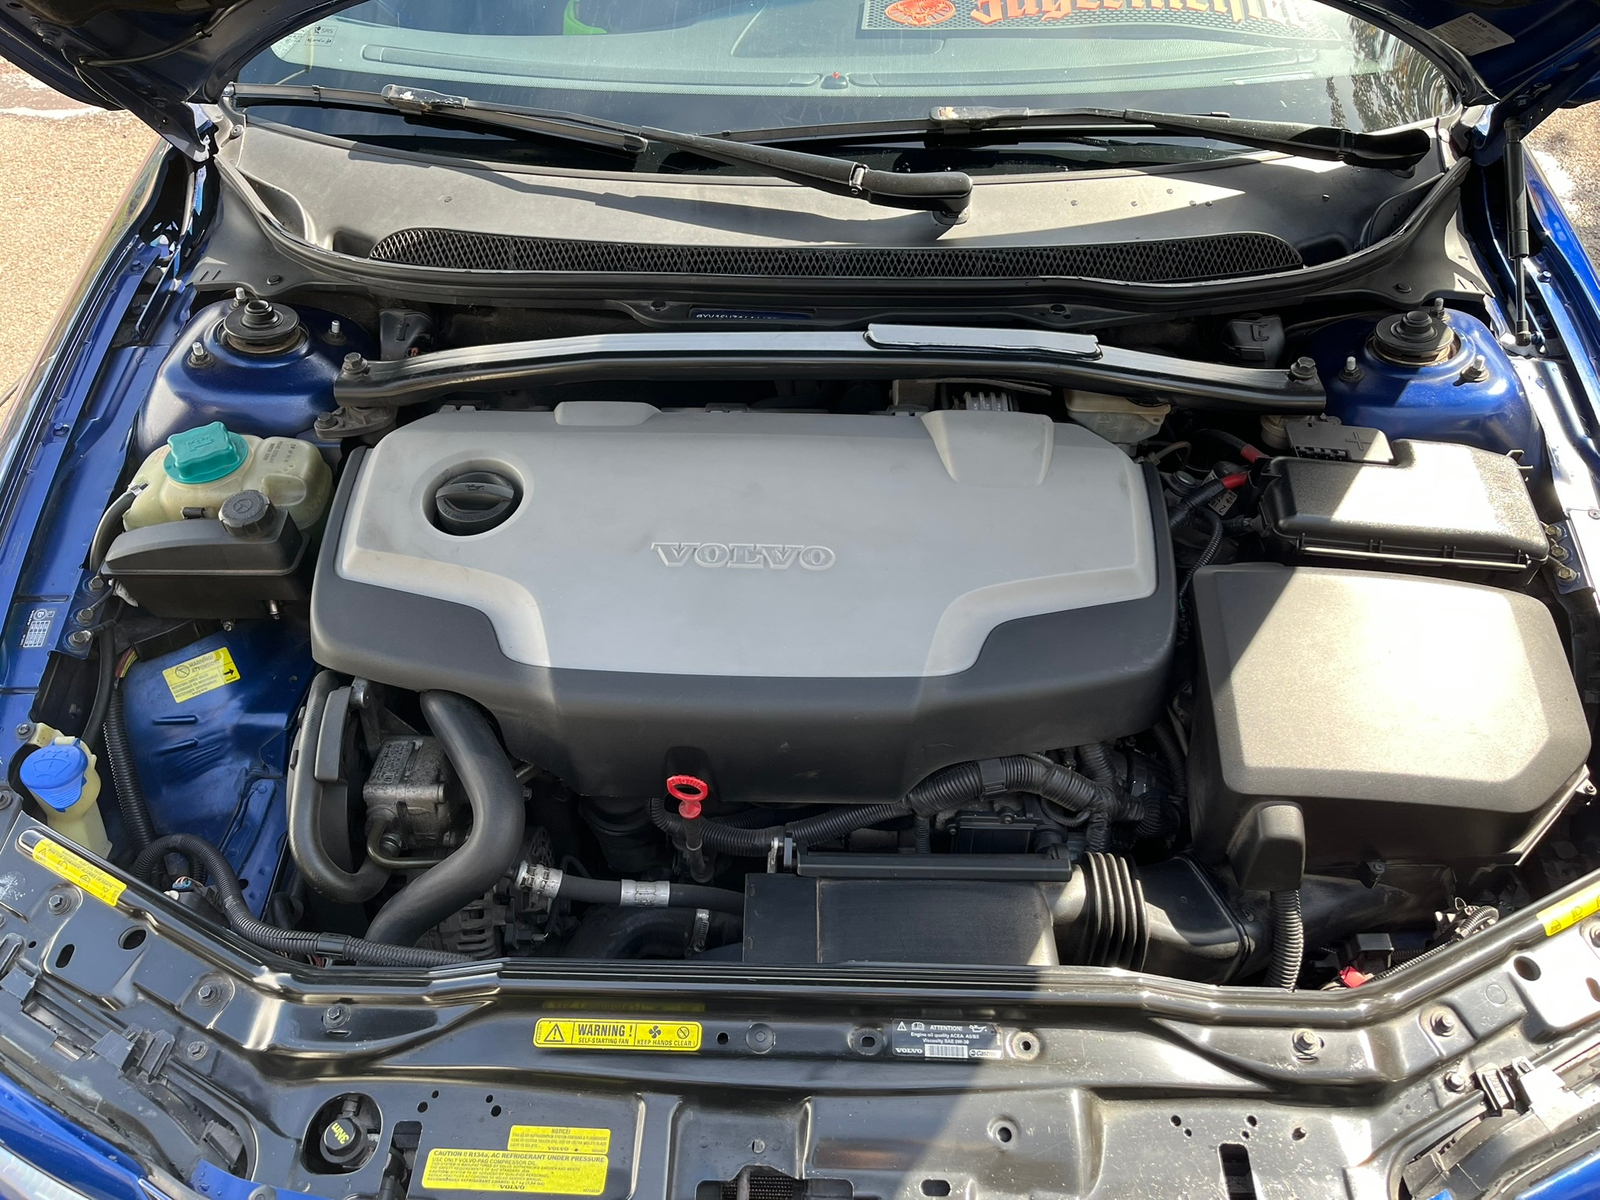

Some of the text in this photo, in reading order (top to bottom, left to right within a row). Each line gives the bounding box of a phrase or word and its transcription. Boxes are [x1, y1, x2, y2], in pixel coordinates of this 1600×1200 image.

[651, 542, 836, 571] VOLVO
[578, 1024, 626, 1036] WARNING
[331, 1122, 350, 1145] 3Nm
